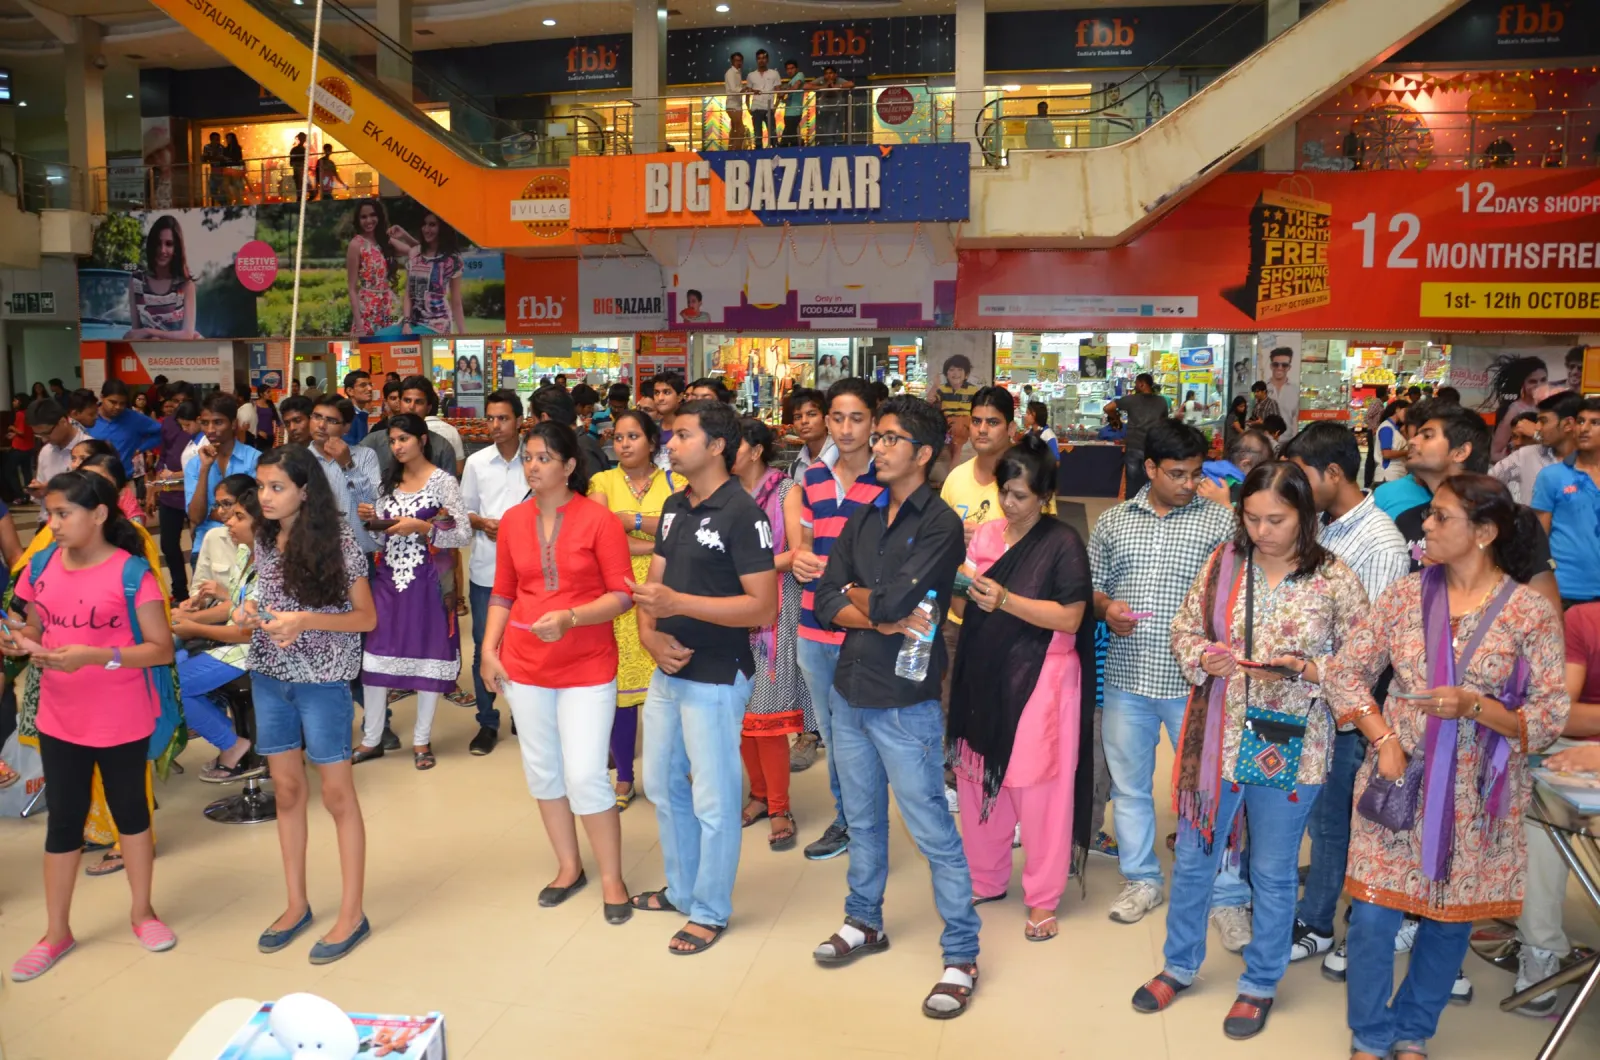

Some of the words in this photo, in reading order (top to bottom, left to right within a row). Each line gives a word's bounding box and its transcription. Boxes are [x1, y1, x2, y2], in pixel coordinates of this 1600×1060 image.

[1495, 3, 1564, 35] fbb
[810, 28, 866, 57] fbb
[1075, 18, 1134, 47] fbb
[258, 45, 300, 82] NAHIN
[566, 45, 617, 73] fbb
[362, 120, 383, 142] EK
[382, 136, 449, 188] ANUBHAV
[645, 160, 711, 214] BIG
[724, 155, 881, 212] BAZAAR
[520, 203, 567, 215] VILLAG
[1285, 208, 1317, 226] THE
[1262, 222, 1280, 238] 12
[1284, 225, 1331, 241] MONTH
[1351, 212, 1421, 269] 12
[238, 257, 276, 265] FESTIVE
[1265, 240, 1328, 266] FREE
[1260, 266, 1329, 284] SHOPPING
[815, 295, 832, 303] Only
[1258, 278, 1330, 301] FESTIVAL
[1484, 291, 1521, 309] 12th
[1528, 291, 1600, 309] OCTOBE
[517, 296, 563, 320] fbb
[802, 306, 822, 314] FOOD
[823, 306, 854, 314] BAZAAR
[148, 357, 184, 366] BAGGAGE
[754, 520, 773, 549] 10
